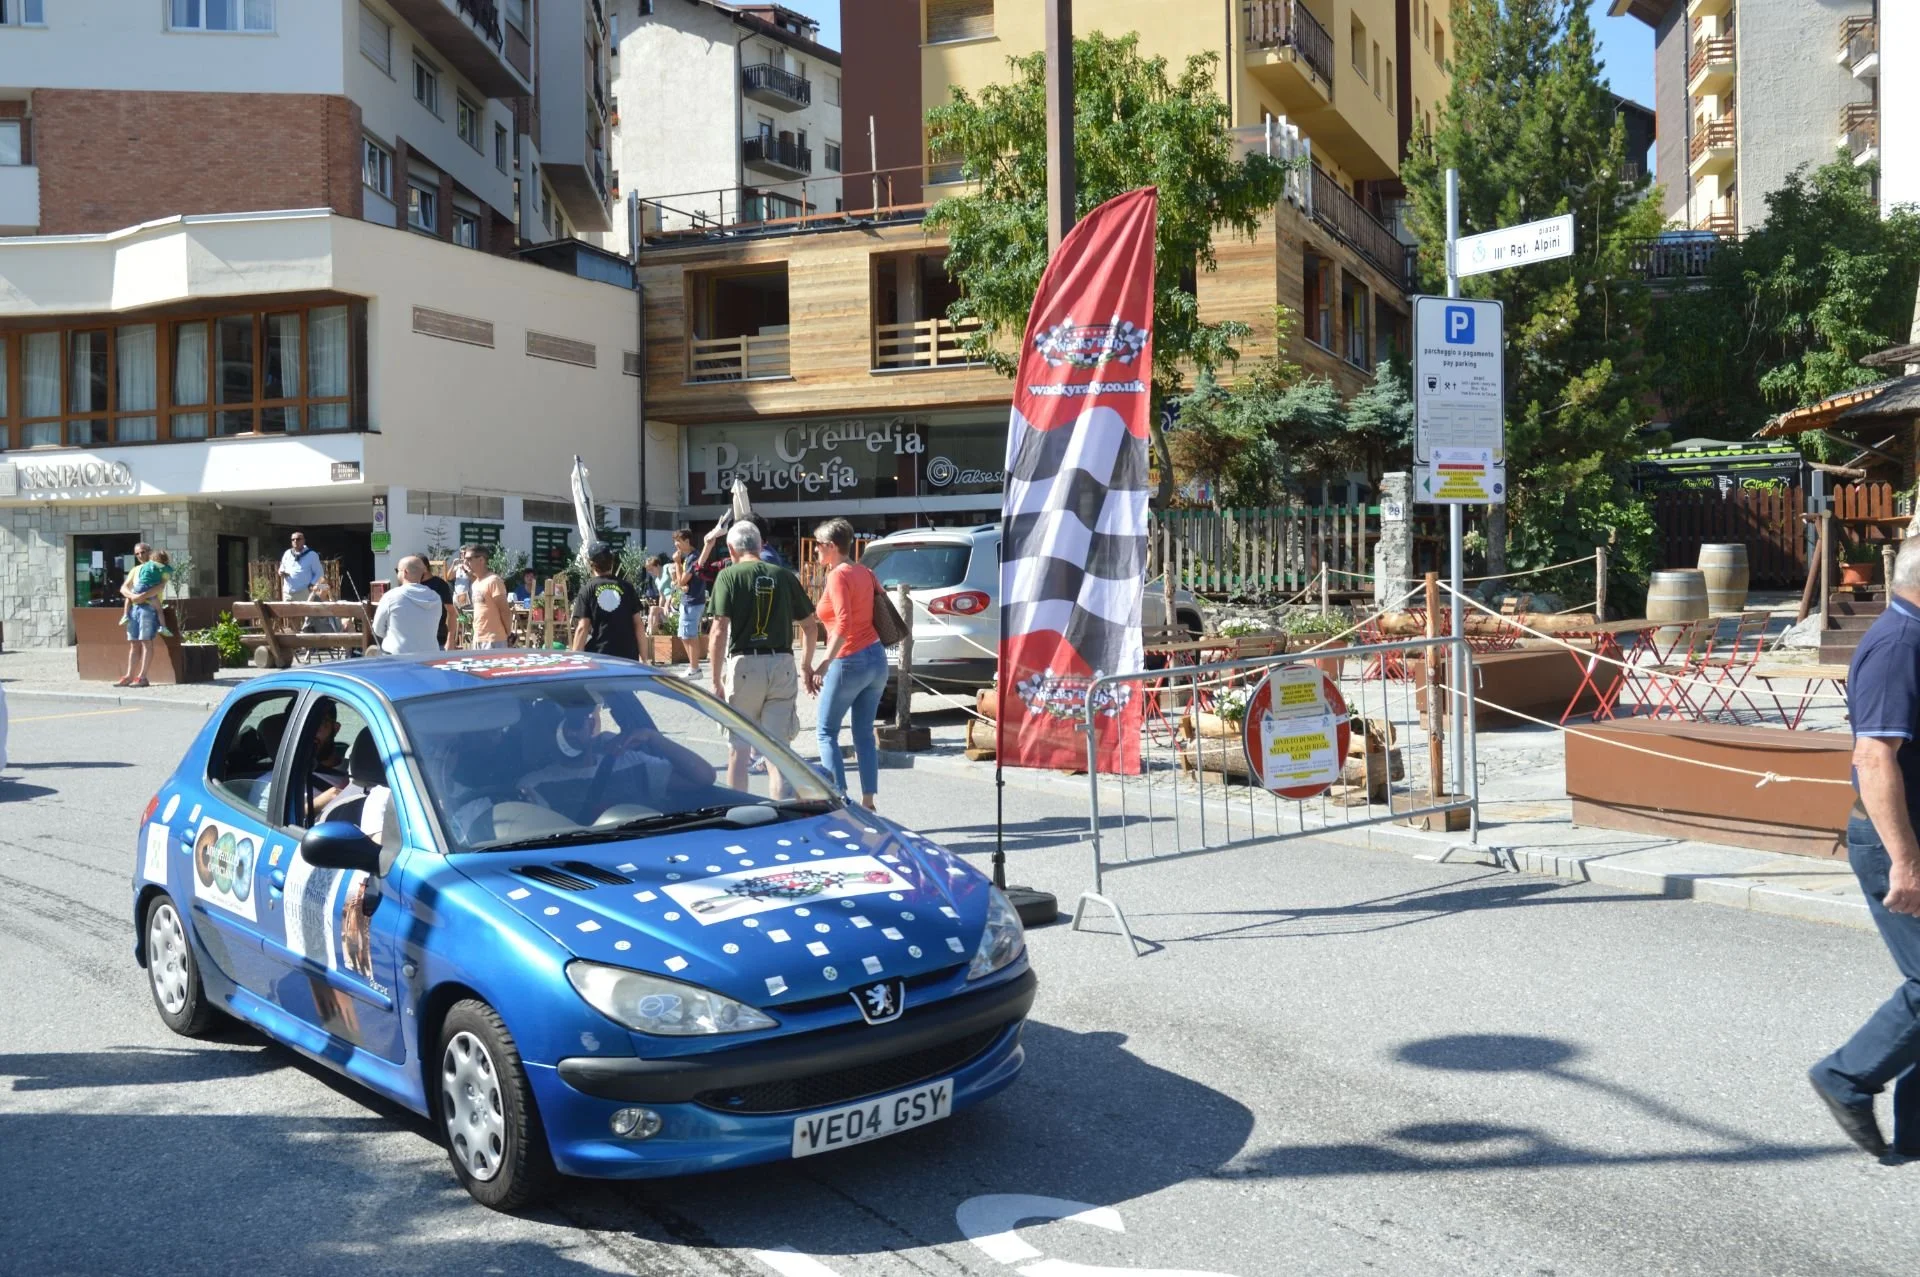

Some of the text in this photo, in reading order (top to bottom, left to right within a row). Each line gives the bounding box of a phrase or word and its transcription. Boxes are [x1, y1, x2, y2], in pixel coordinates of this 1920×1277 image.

[1510, 242, 1530, 259] Rgt.
[1534, 237, 1561, 254] Alpini
[1451, 311, 1469, 339] P
[1055, 336, 1126, 353] Wacky Rally
[1424, 347, 1457, 358] parcheggio
[1462, 350, 1494, 359] pagamento
[1443, 360, 1477, 369] pay parking
[1029, 379, 1146, 397] wackyrally.co.uk
[775, 416, 925, 463] Cremeria
[23, 461, 131, 489] SANPAOLO
[701, 441, 858, 495] Pasticceria
[1078, 689, 1110, 705] Rlly
[807, 1104, 883, 1149] VE04
[894, 1085, 945, 1126] GSY
